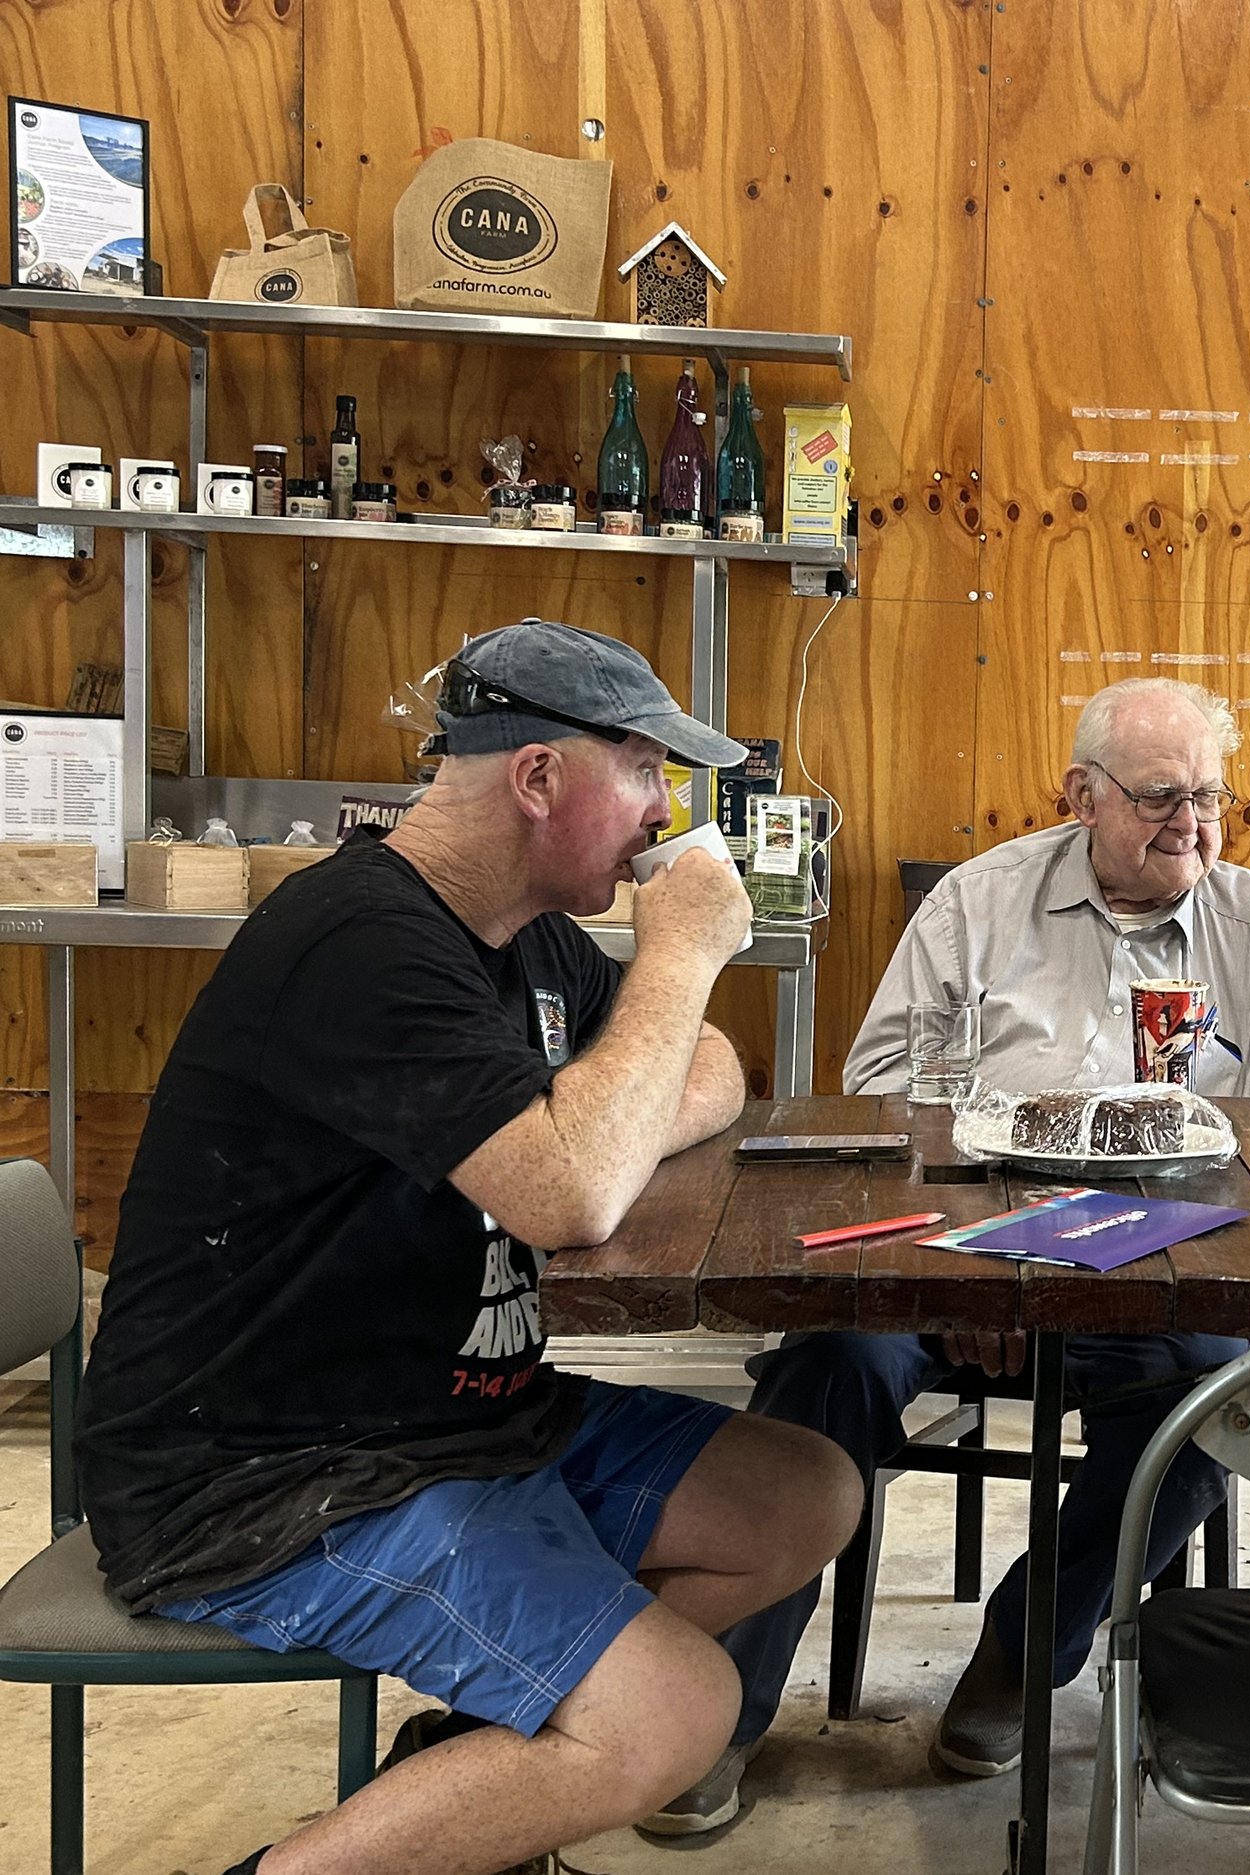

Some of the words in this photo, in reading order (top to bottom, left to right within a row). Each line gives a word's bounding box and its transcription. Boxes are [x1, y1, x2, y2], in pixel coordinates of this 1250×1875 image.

[461, 208, 529, 235] CANA
[265, 282, 293, 292] CANA
[426, 278, 552, 299] anafarm.com.au
[60, 475, 71, 484] CA
[451, 1369, 504, 1398] 7-14
